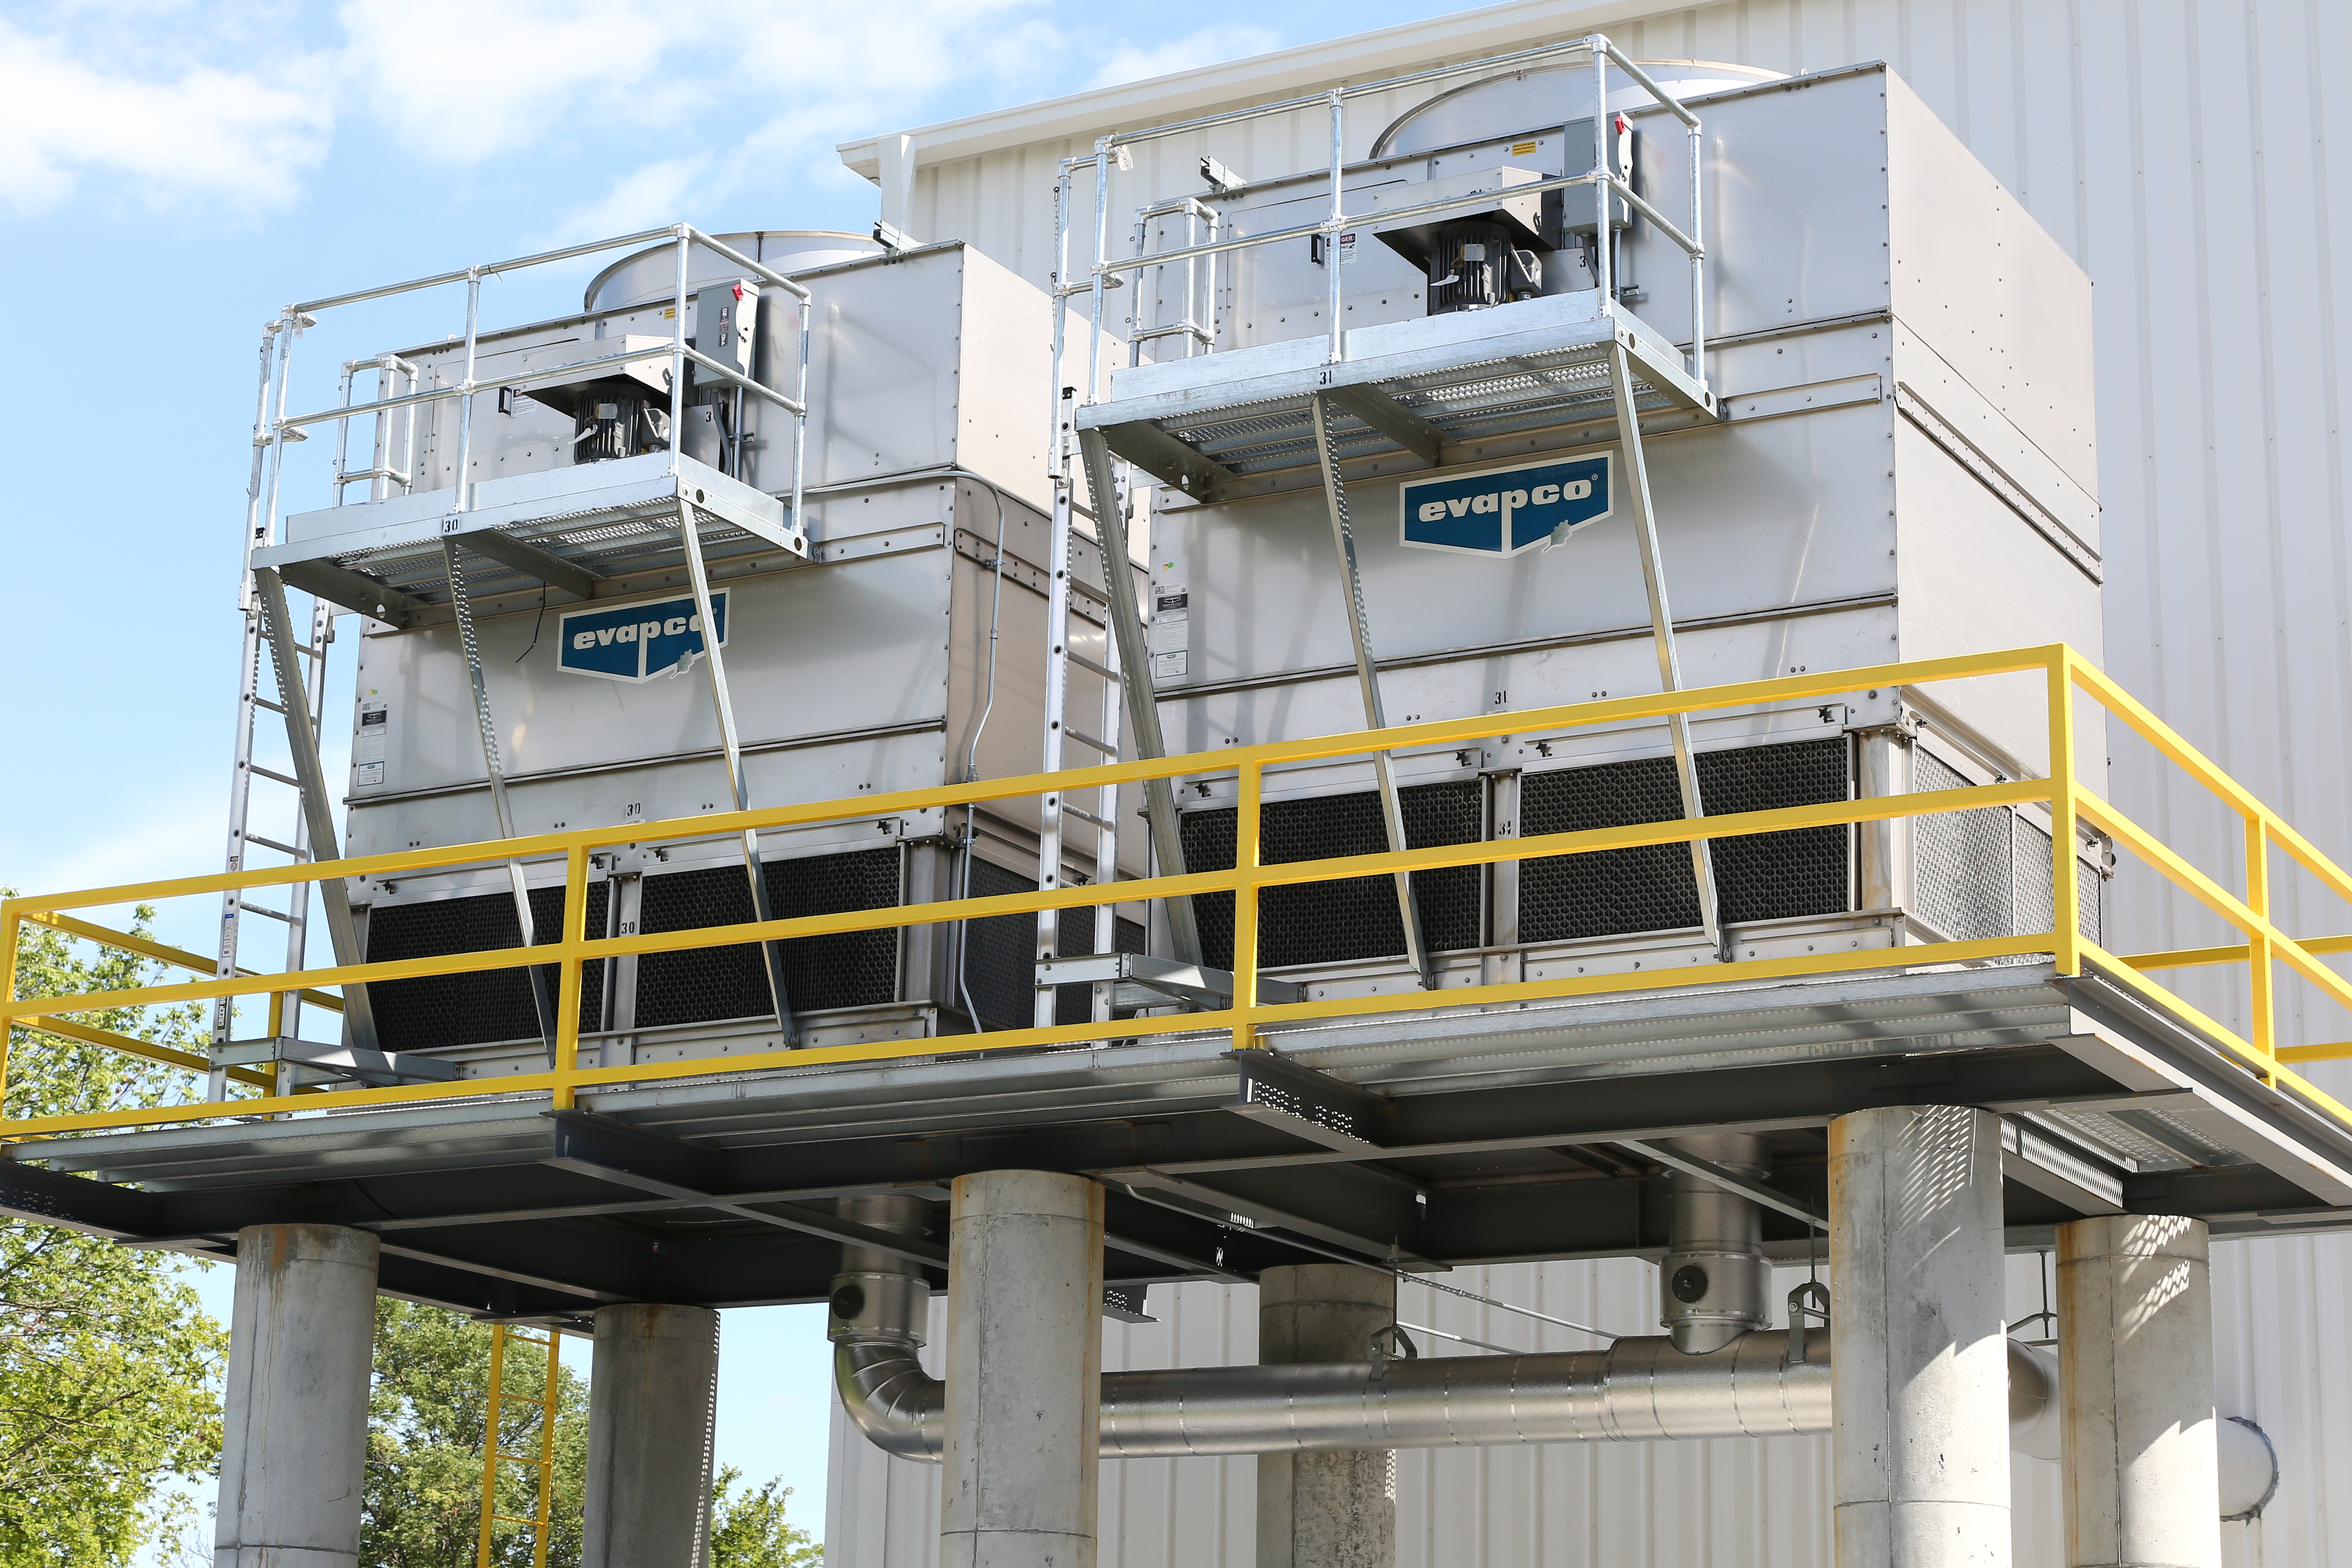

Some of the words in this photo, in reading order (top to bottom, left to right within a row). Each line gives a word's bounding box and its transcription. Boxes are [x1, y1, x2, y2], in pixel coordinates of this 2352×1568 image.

[1579, 255, 1586, 267] 3
[722, 308, 727, 317] ON
[1319, 370, 1331, 385] 31
[706, 411, 712, 422] 3
[445, 519, 458, 533] 30
[351, 553, 371, 561] SAW
[1495, 690, 1506, 705] 31
[627, 802, 640, 816] 30
[622, 921, 635, 934] 30
